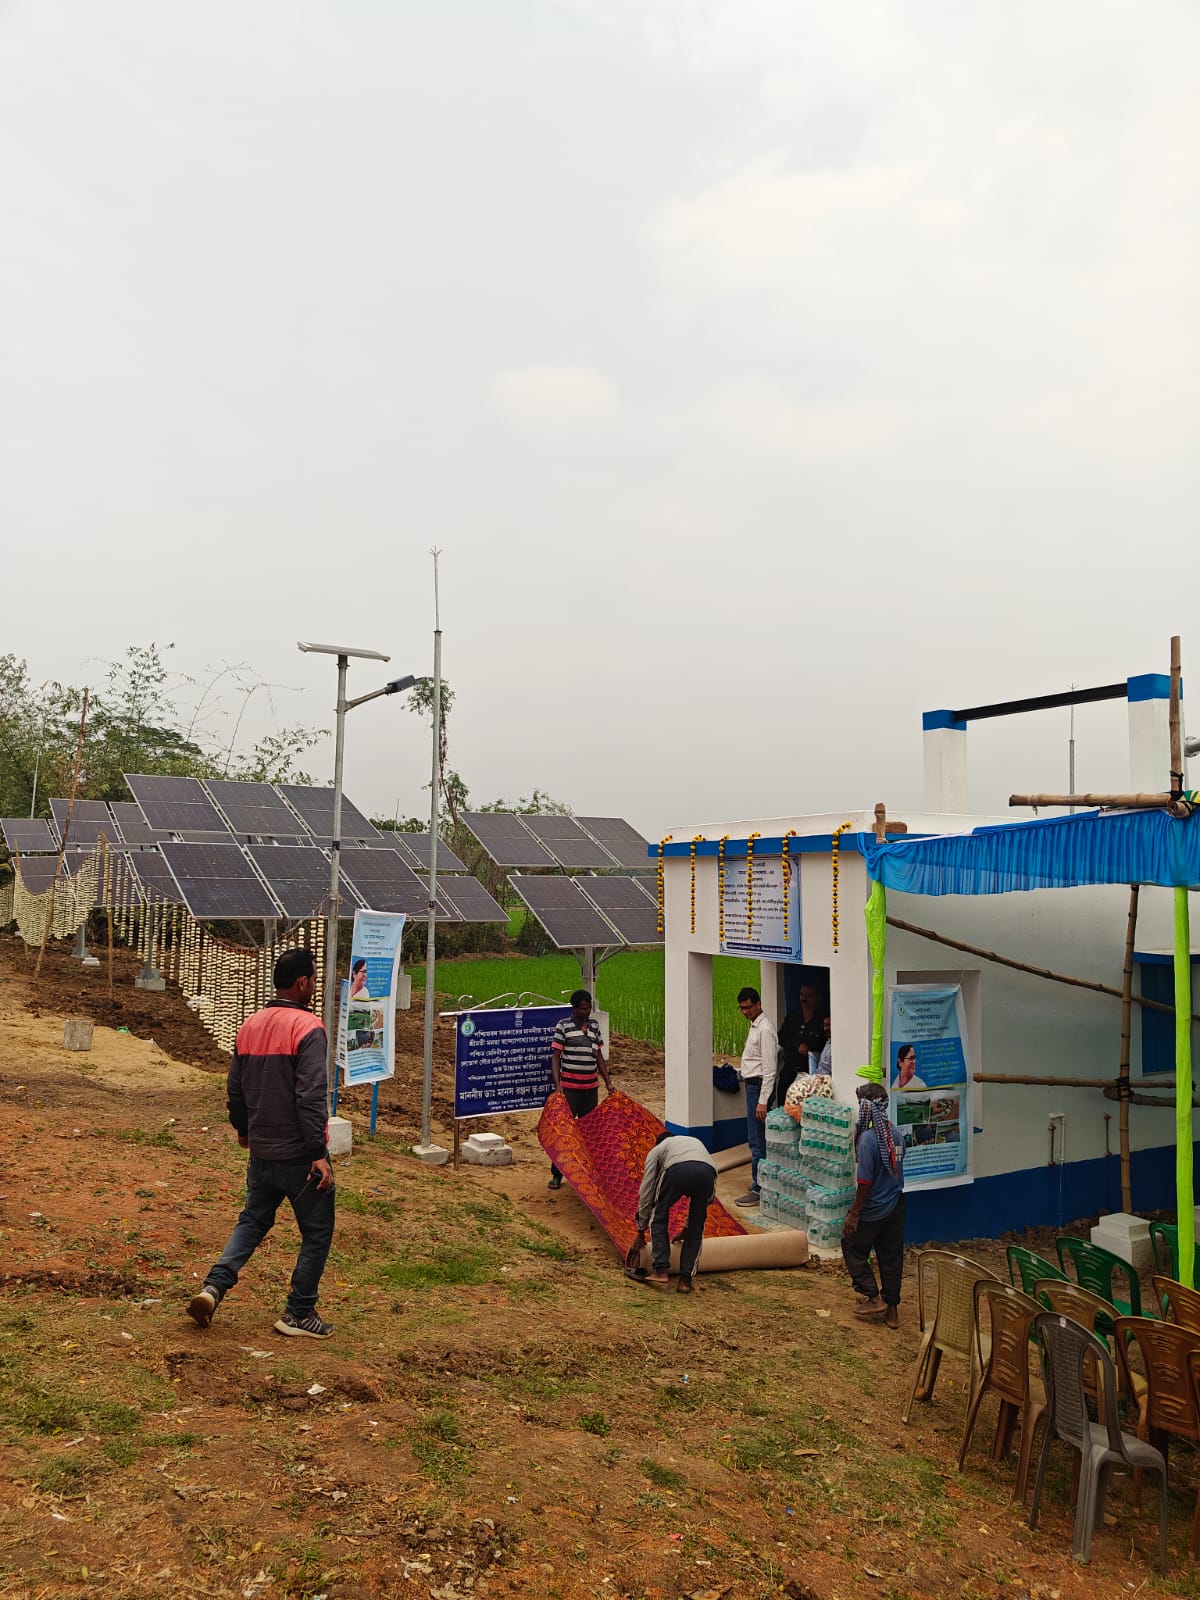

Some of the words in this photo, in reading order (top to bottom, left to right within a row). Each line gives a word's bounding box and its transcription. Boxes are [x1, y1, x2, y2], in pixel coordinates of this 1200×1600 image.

[459, 1088, 483, 1100] মাননীয়
[484, 1089, 496, 1098] ডাঃ
[497, 1087, 514, 1096] মানস
[515, 1086, 531, 1096] রঞ্জন
